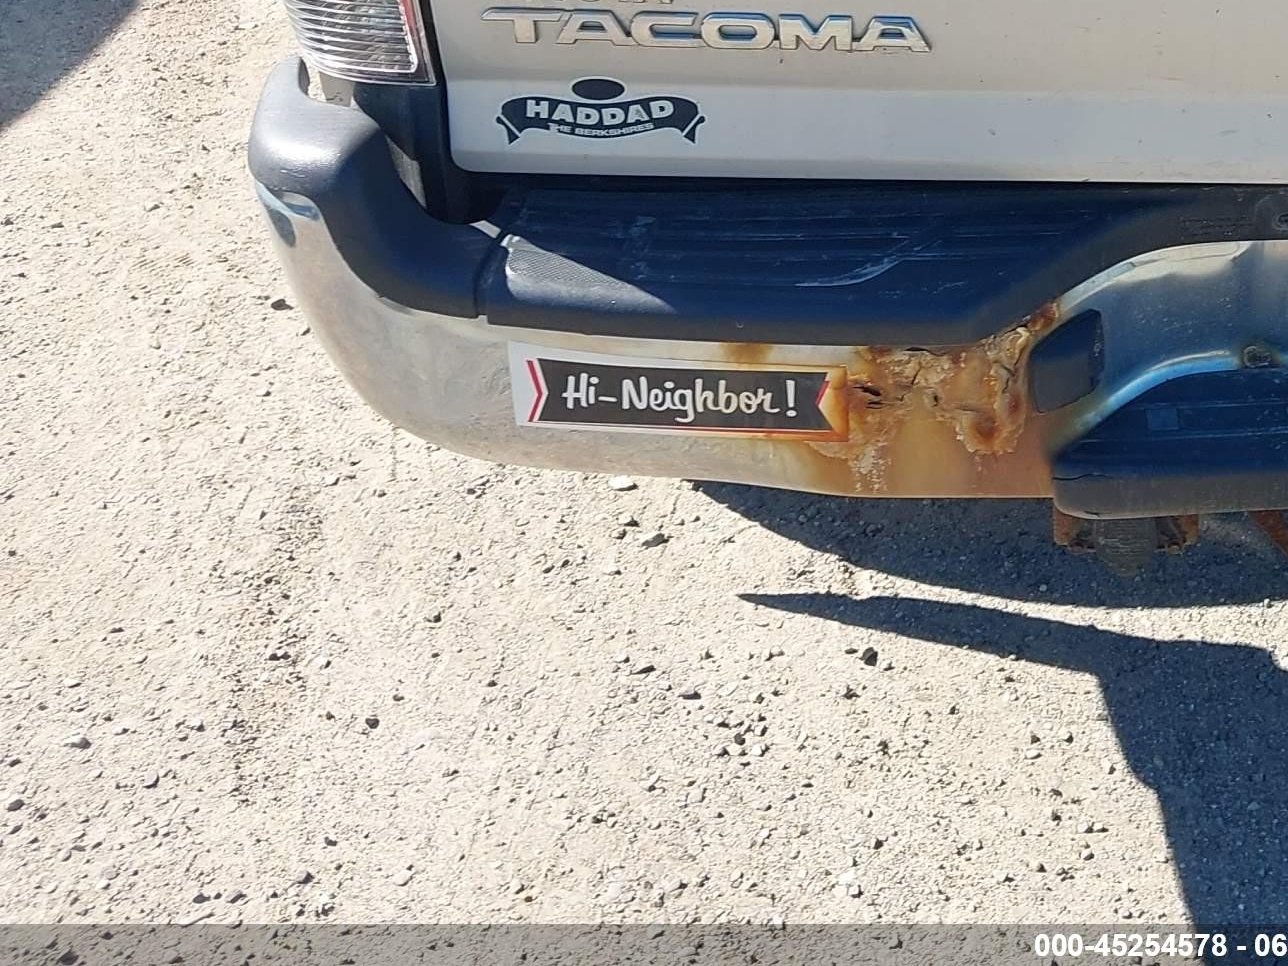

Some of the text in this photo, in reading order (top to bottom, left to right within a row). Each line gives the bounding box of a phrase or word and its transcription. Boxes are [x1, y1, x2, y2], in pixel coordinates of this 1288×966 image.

[480, 7, 932, 52] TACOMA
[526, 99, 675, 126] HADDAD
[574, 122, 655, 136] BERKSHIRES
